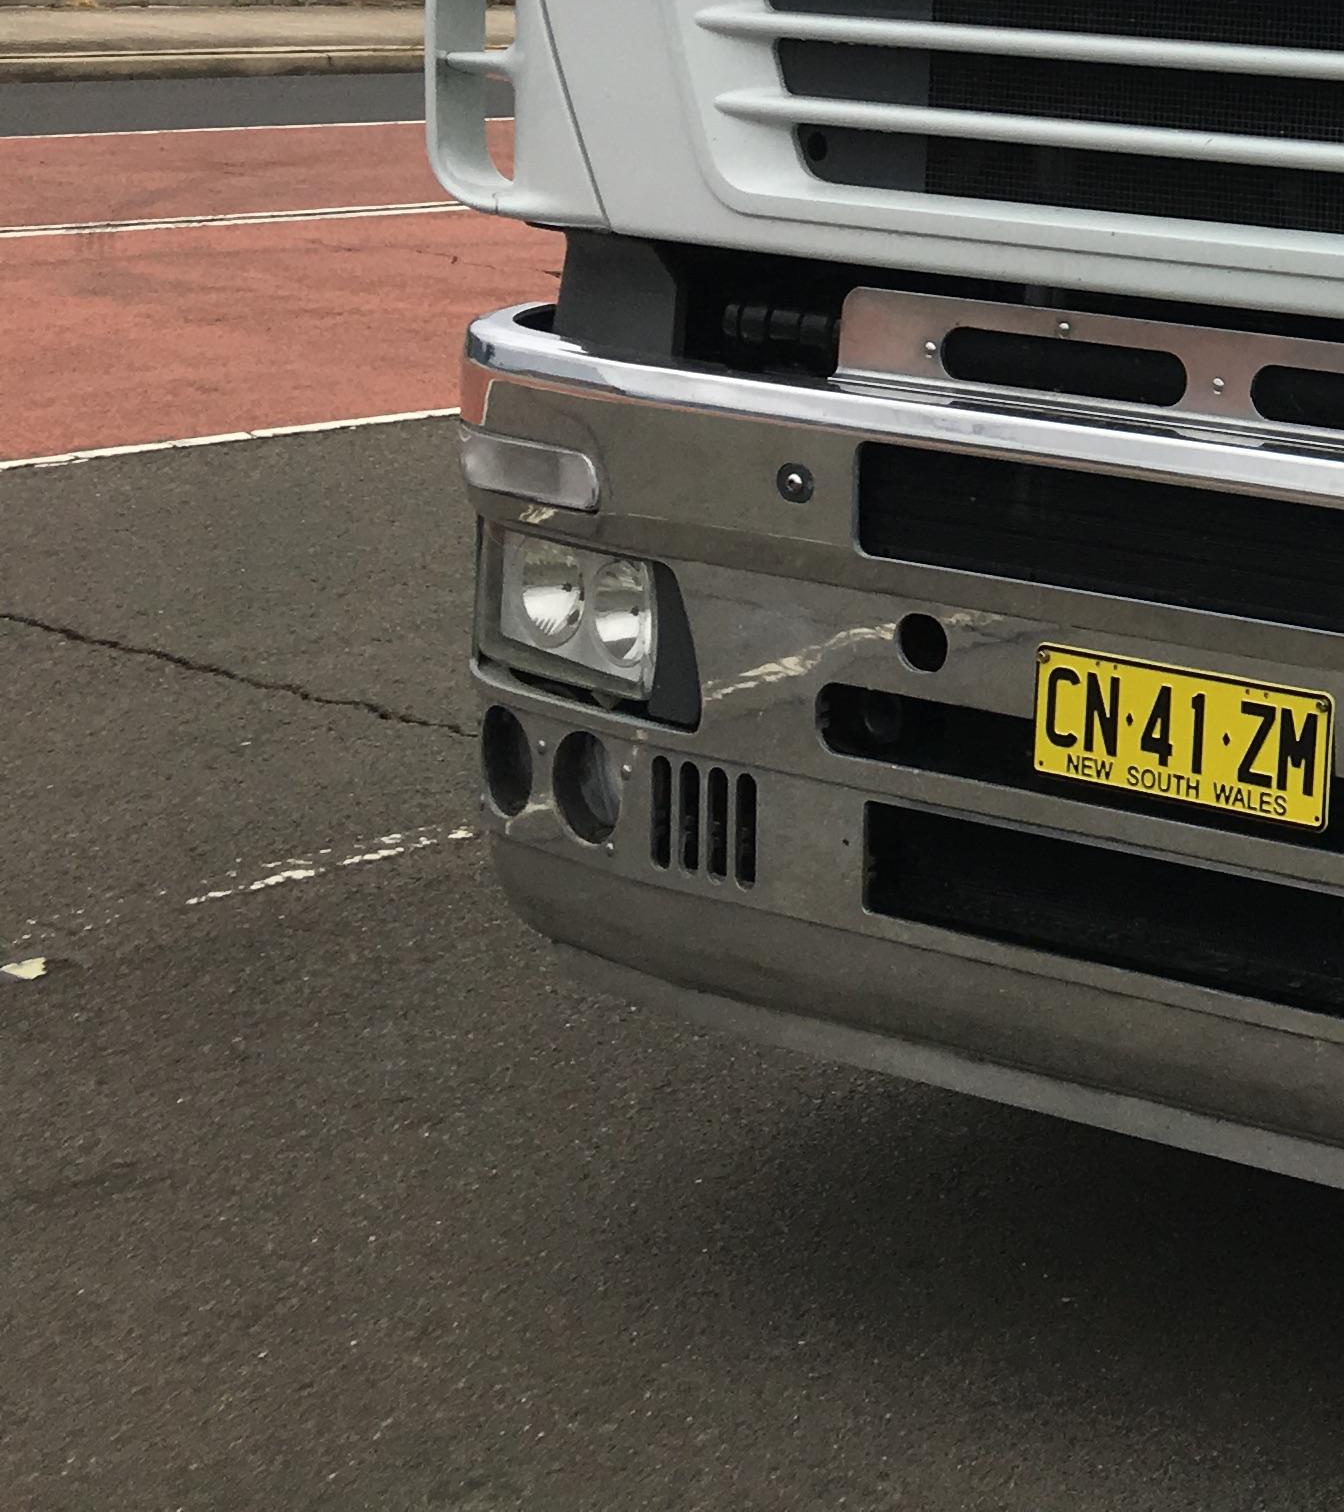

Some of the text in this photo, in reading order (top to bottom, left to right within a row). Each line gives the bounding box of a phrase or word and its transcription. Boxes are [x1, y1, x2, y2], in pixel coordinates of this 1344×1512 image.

[1066, 753, 1288, 817] NEW SOUTH WALES
